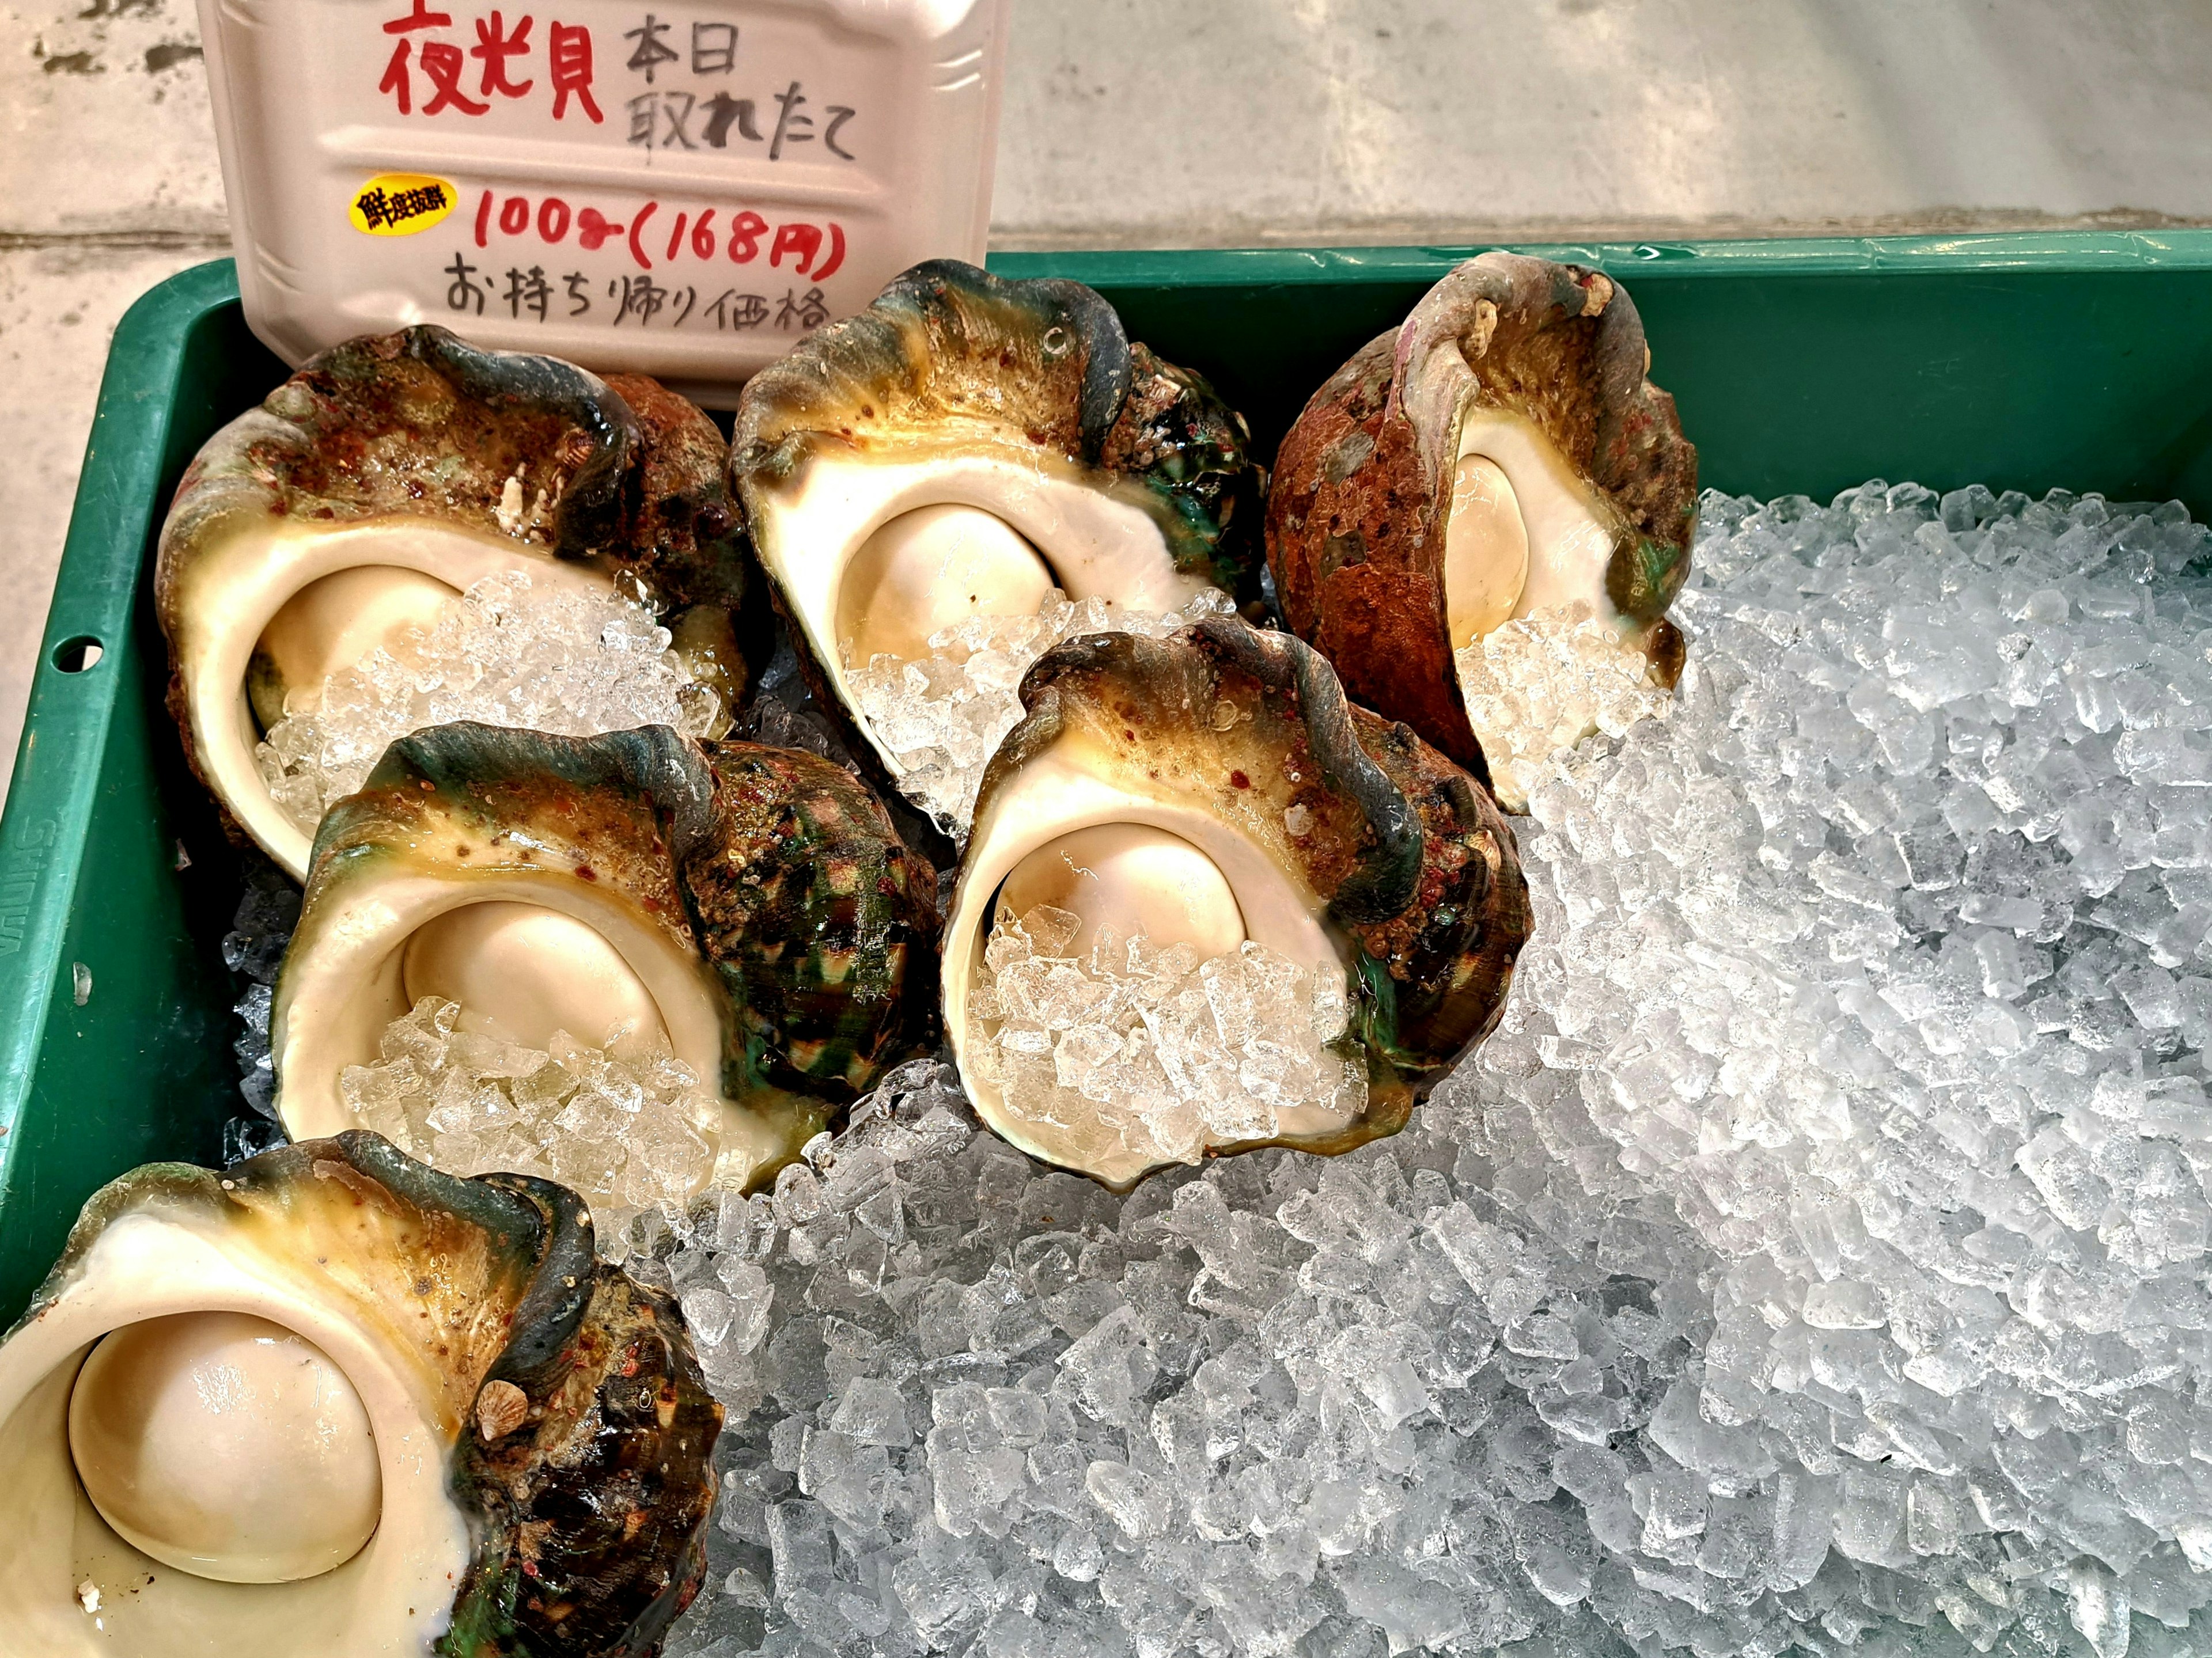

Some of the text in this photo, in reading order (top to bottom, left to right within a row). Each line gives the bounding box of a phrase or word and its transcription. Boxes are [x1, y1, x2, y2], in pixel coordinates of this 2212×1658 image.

[379, 0, 604, 123] 夜光貝
[624, 15, 738, 84] 本日
[625, 82, 855, 164] 取れたて
[357, 184, 447, 230] 鮮度抜群
[445, 252, 830, 331] お持ち帰り価格
